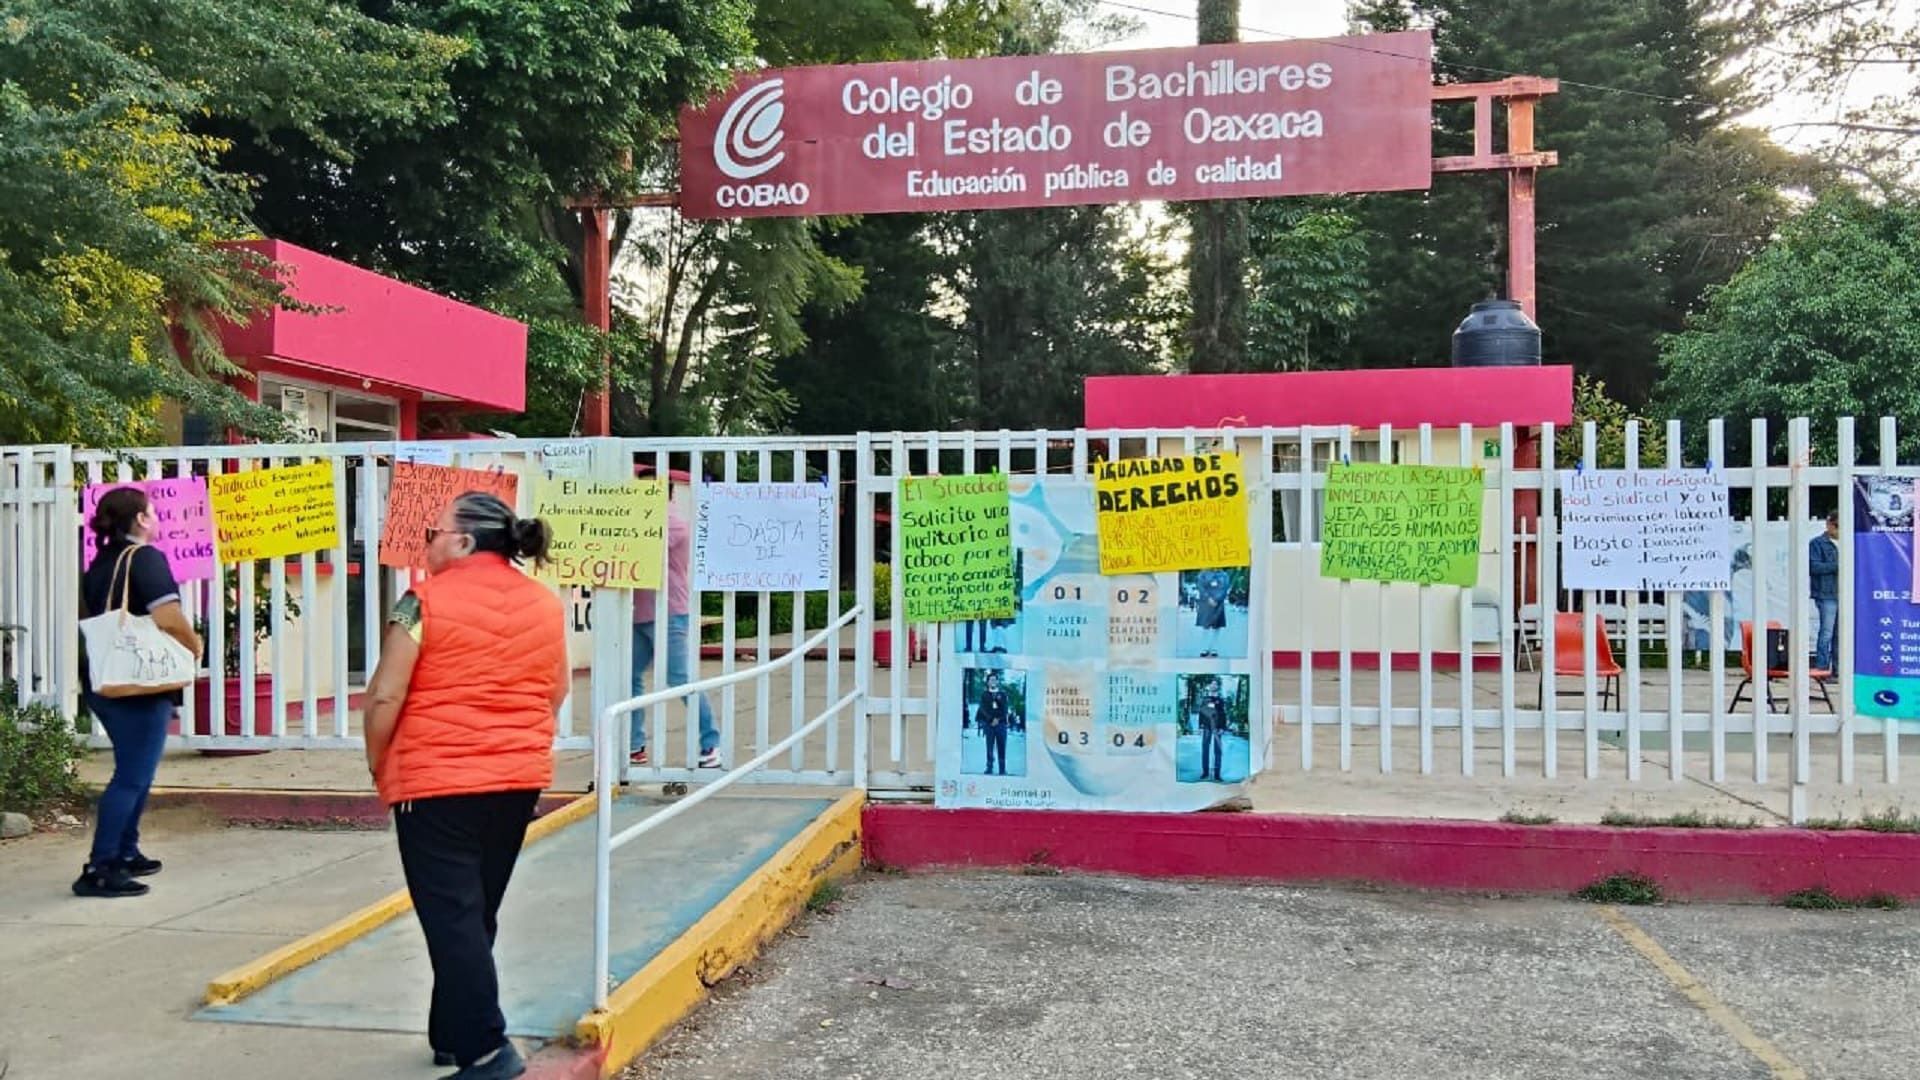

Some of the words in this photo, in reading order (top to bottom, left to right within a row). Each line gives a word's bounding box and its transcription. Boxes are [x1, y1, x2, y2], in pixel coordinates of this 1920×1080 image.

[842, 75, 973, 121] Colegio
[1015, 70, 1063, 106] de
[1105, 59, 1333, 101] Bachilleres
[862, 121, 914, 159] del
[944, 115, 1072, 156] Estado
[1103, 111, 1151, 148] de
[1184, 107, 1323, 145] Oaxaca
[907, 167, 1026, 197] Educación
[1045, 162, 1128, 198] pública
[1147, 160, 1176, 186] de
[1195, 154, 1282, 183] calidad
[716, 183, 809, 208] COBAO
[1100, 457, 1185, 482] IGUALDAD
[1193, 455, 1222, 474] DE
[1098, 472, 1240, 513] DERECHOS
[727, 513, 804, 548] BASTA
[1591, 554, 1612, 567] de
[1873, 590, 1899, 600] DEL
